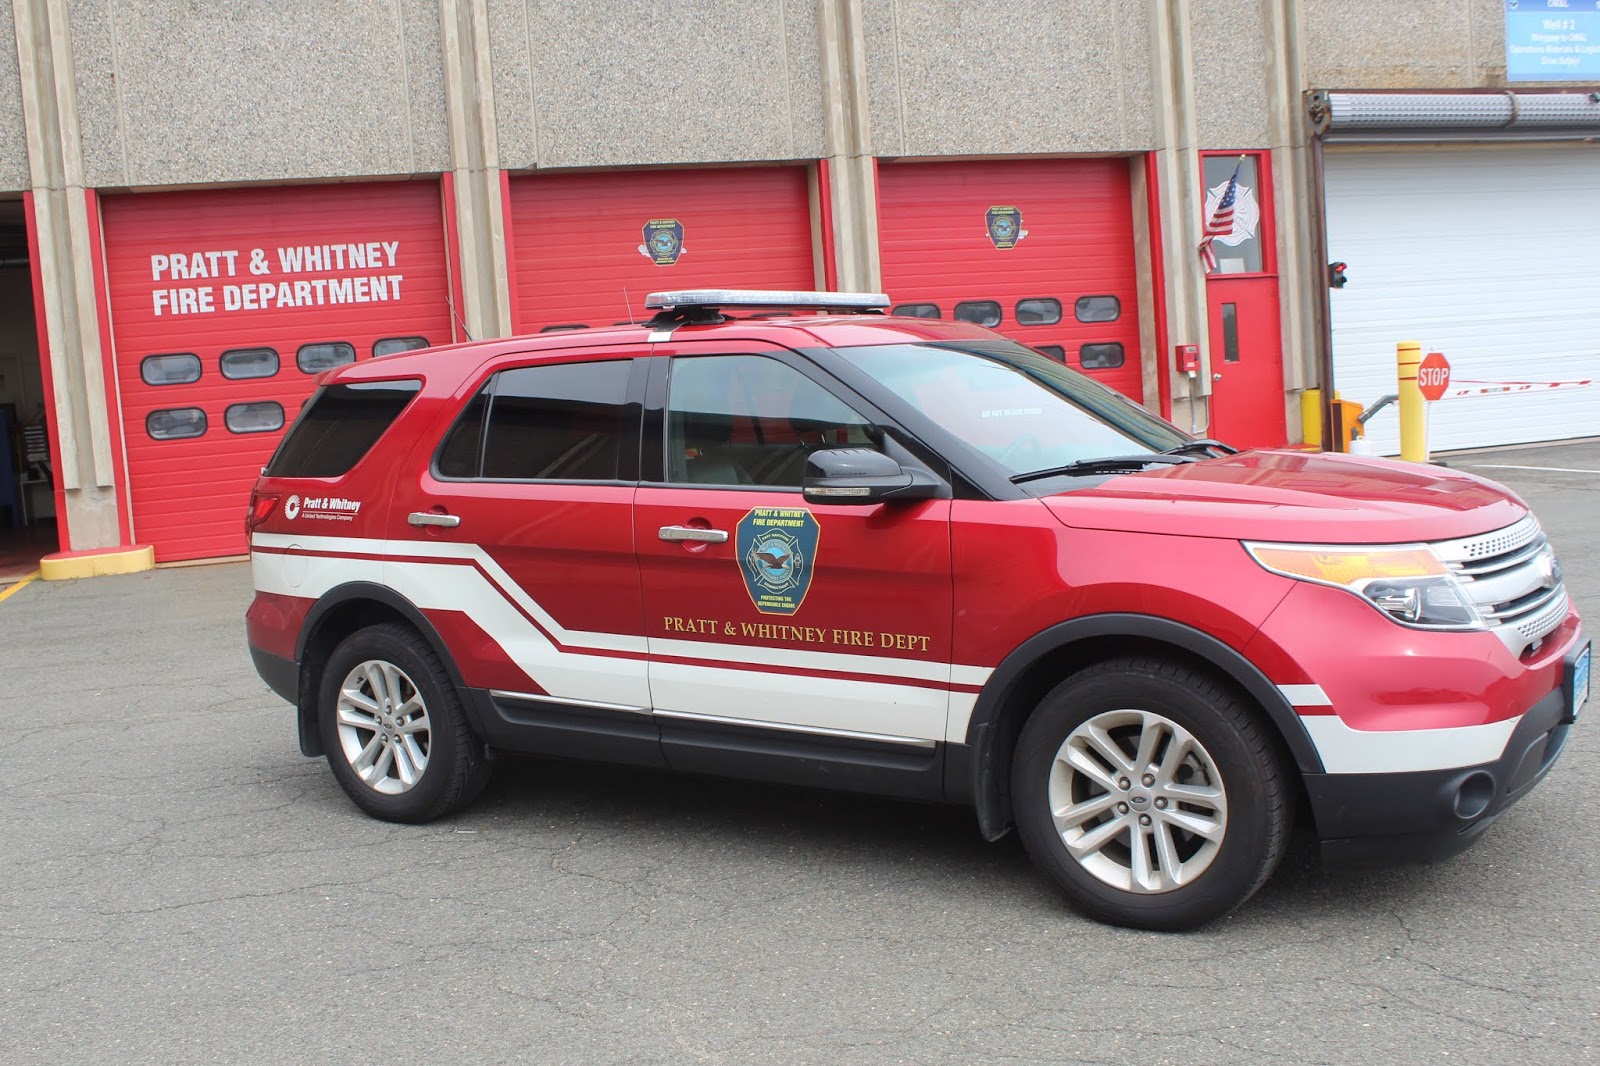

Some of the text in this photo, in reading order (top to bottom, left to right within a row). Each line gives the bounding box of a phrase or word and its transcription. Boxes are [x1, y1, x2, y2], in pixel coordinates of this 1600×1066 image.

[151, 241, 399, 281] PRATT & WHITNEY
[152, 275, 403, 316] FIRE DEPARTMENT
[1419, 367, 1449, 386] STOP
[303, 497, 361, 513] Pratt & Whitney
[754, 509, 772, 517] PRATT
[779, 510, 805, 518] WHITNEY
[752, 518, 804, 528] FIRE DEPARTMENT
[663, 616, 931, 652] PRATT & WHITNEY FIRE DEPT
